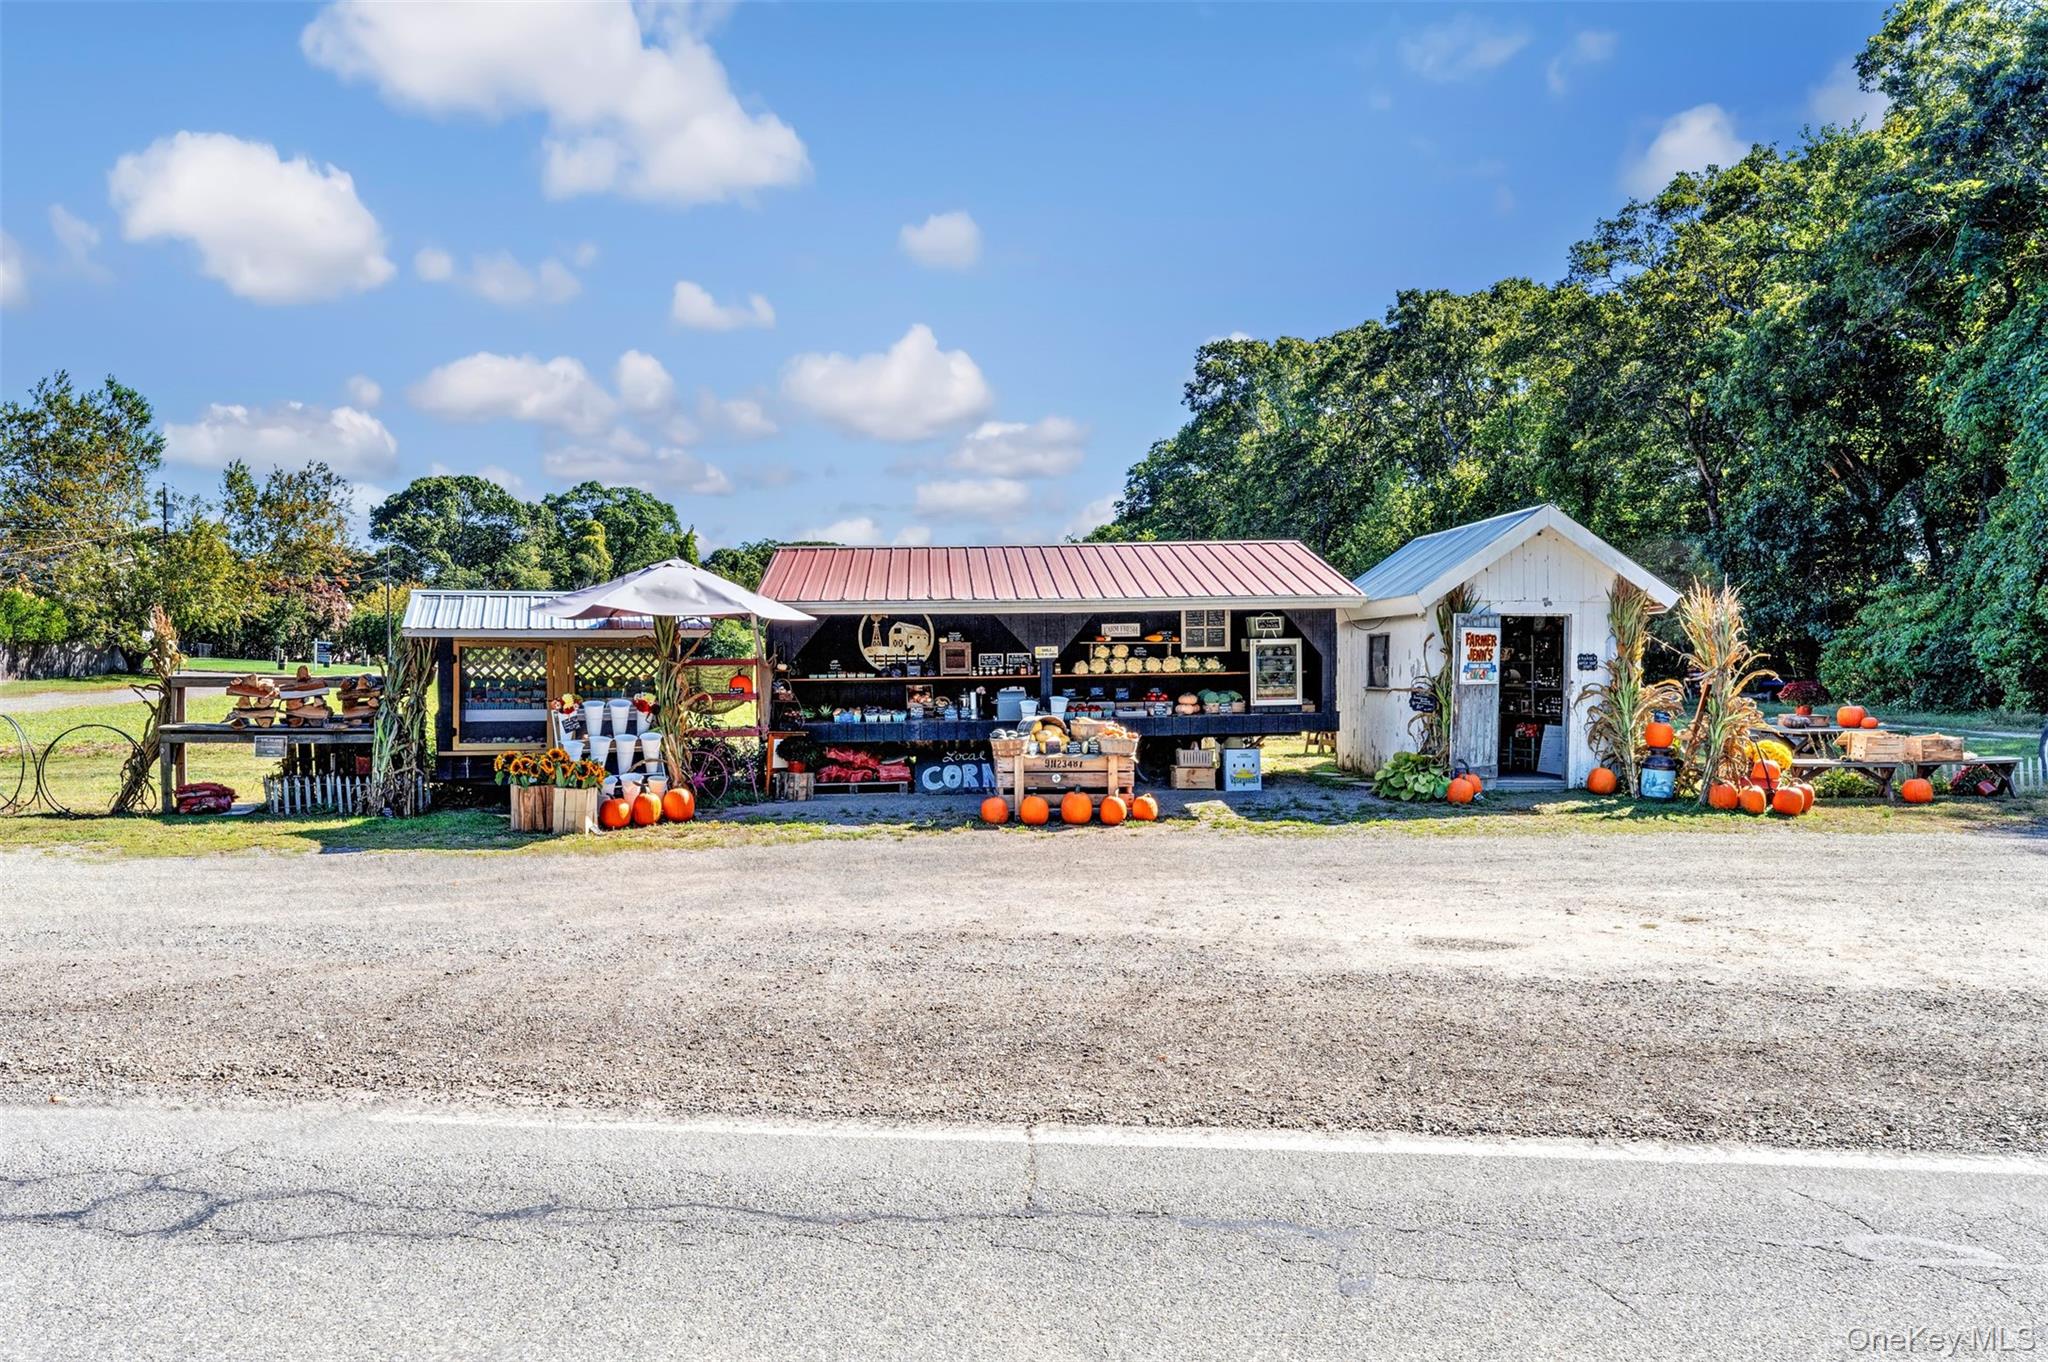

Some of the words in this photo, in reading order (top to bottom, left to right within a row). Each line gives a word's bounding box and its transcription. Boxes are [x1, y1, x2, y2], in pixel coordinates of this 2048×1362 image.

[1466, 632, 1497, 647] FARMER
[1467, 648, 1493, 662] JENN'S
[942, 750, 986, 762] Local
[922, 763, 996, 790] CORN
